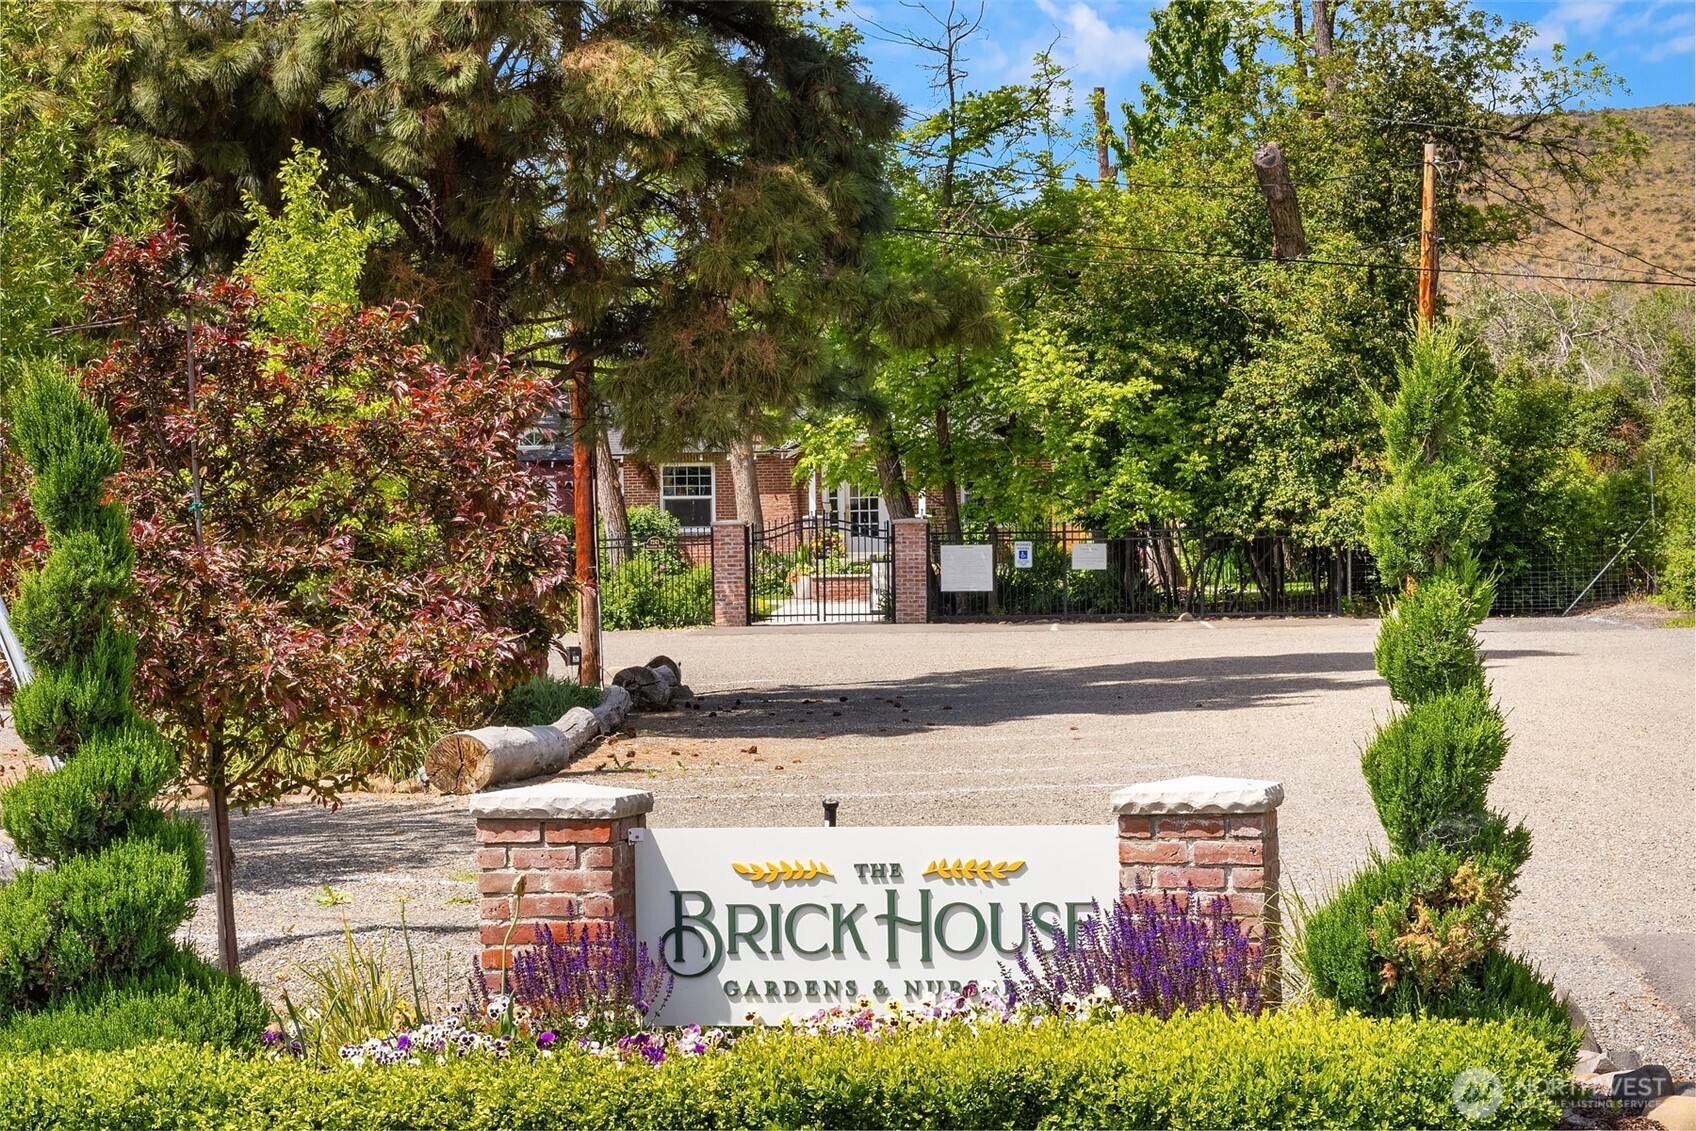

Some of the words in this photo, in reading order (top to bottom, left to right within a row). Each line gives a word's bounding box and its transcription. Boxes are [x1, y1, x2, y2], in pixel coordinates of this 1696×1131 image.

[853, 862, 902, 878] THE
[661, 889, 868, 978] BRICK
[723, 979, 858, 997] GARDENS
[872, 979, 889, 997] &
